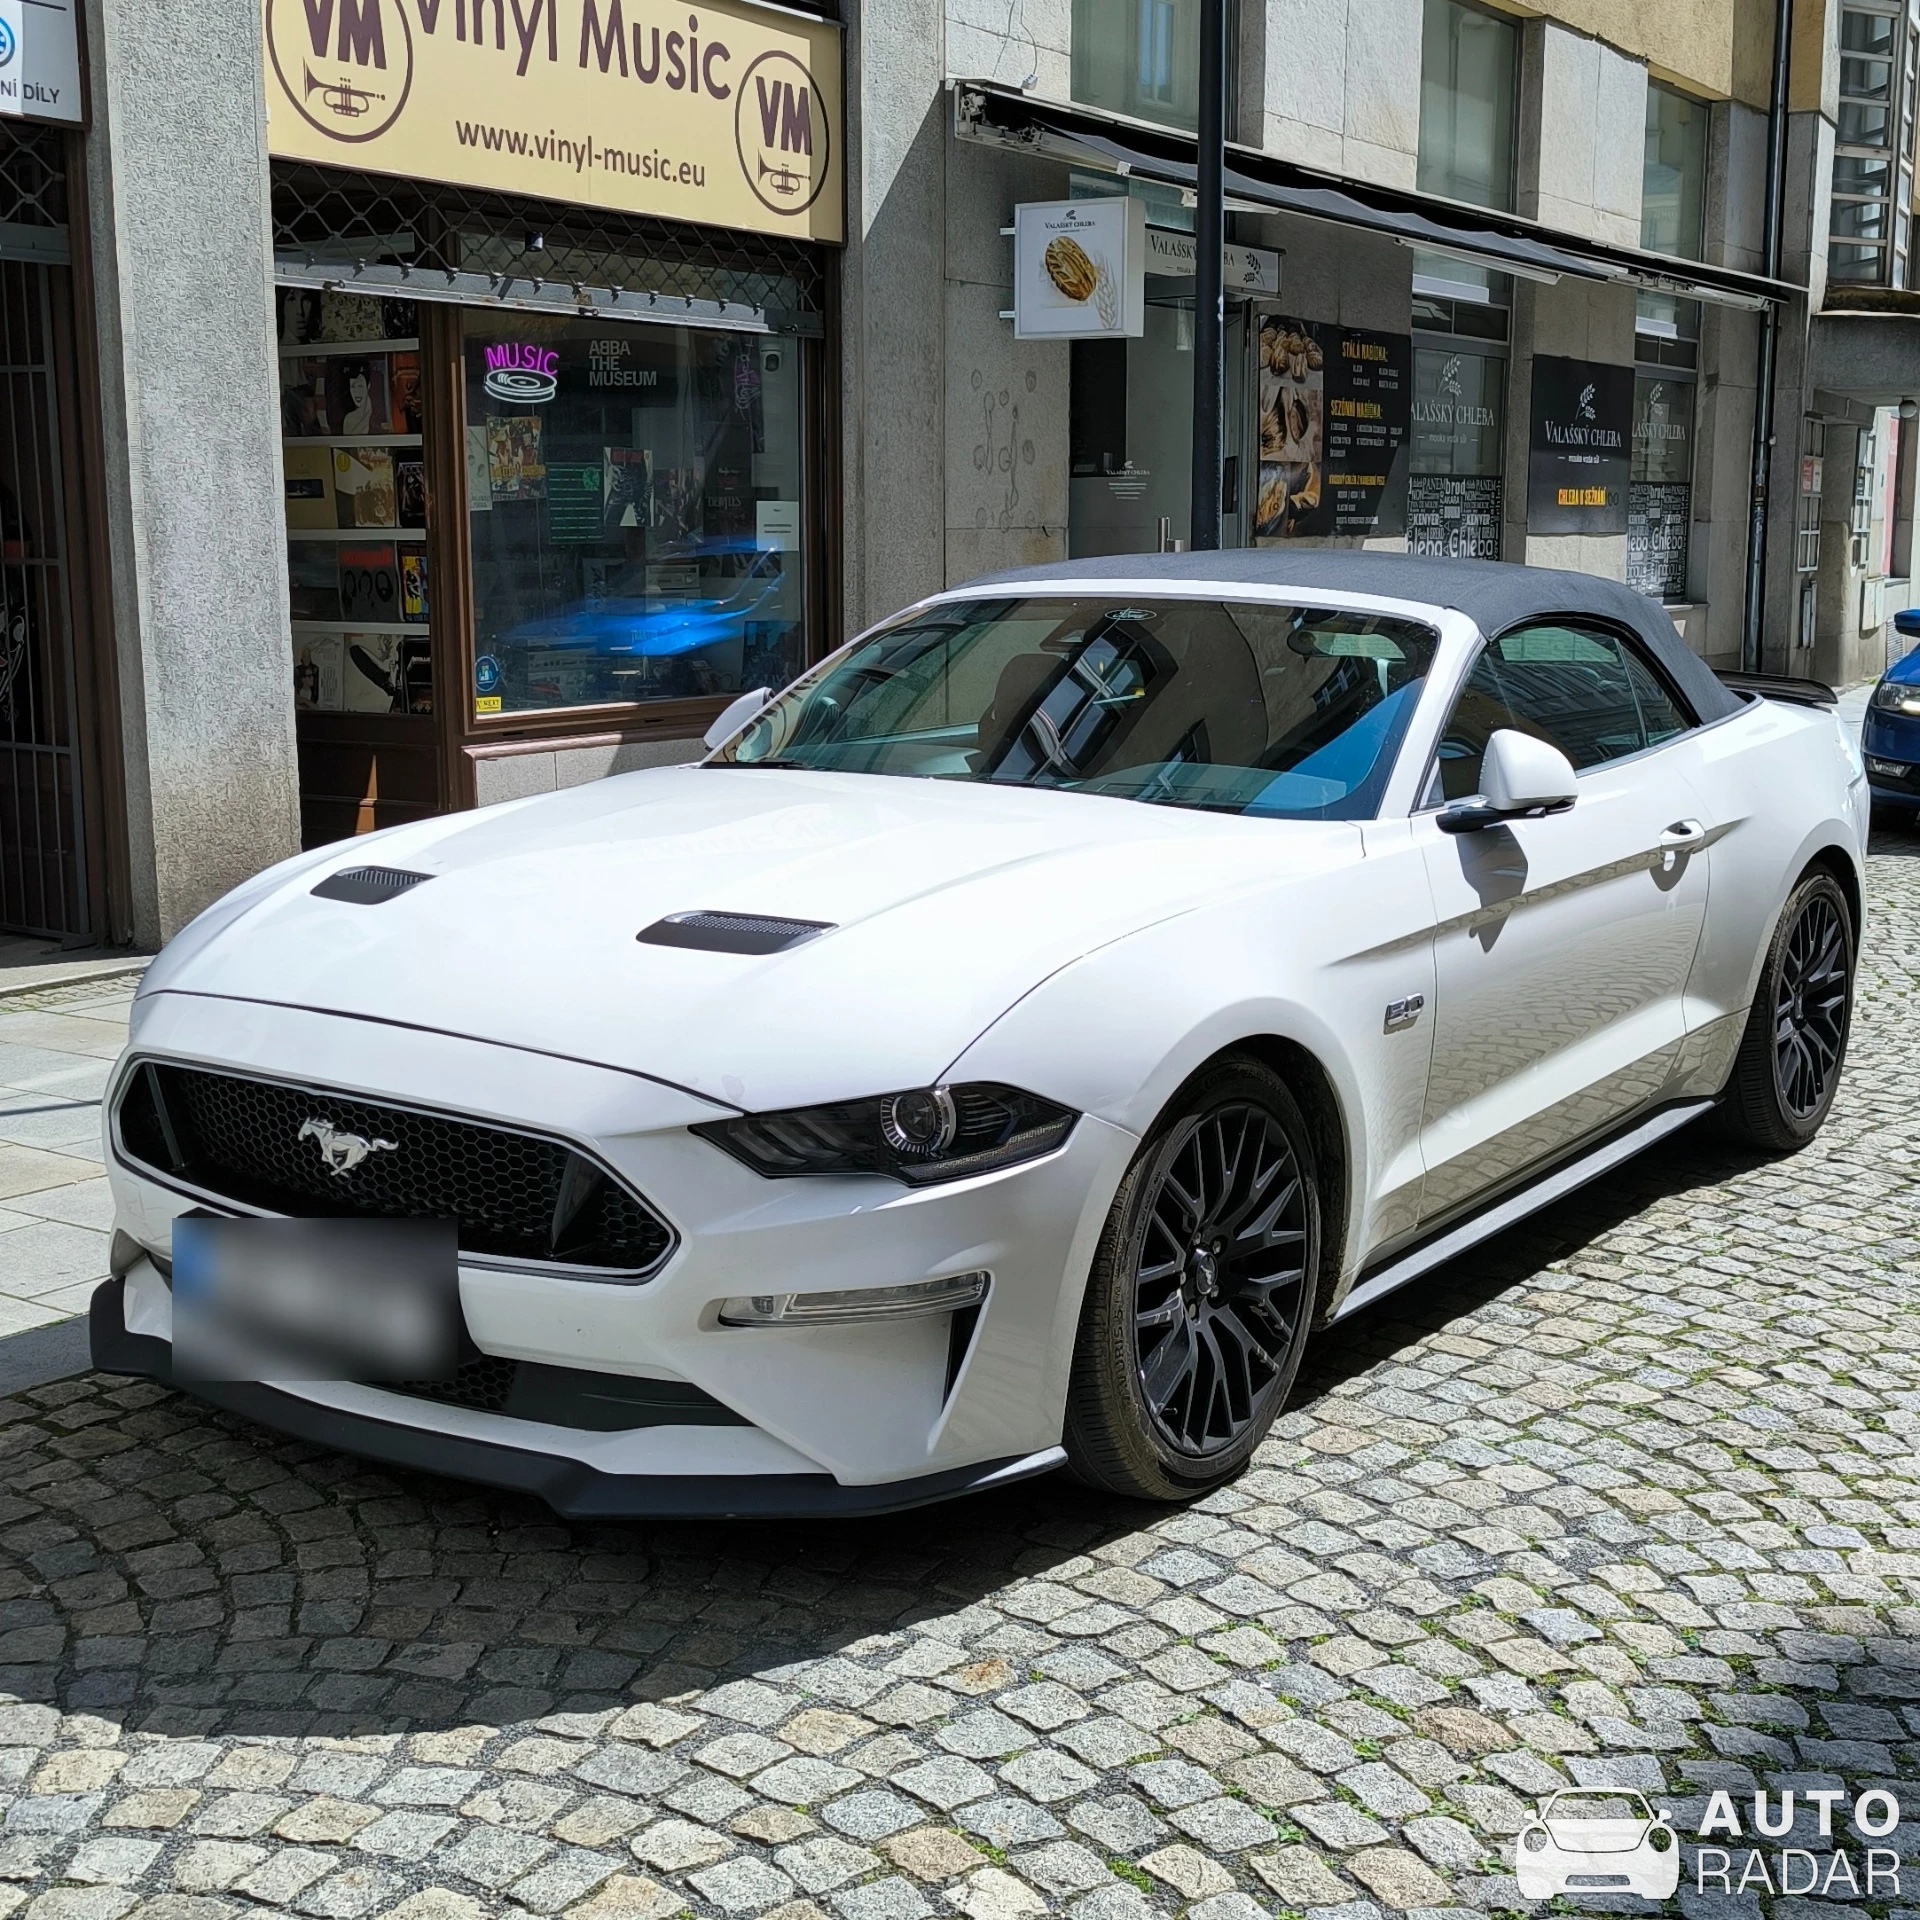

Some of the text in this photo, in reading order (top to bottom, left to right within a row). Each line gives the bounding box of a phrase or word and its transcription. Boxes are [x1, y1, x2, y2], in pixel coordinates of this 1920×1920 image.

[303, 0, 387, 70] VM
[579, 0, 731, 100] Music
[23, 82, 60, 104] DÍLY
[755, 75, 813, 156] VM
[455, 120, 706, 188] www.vinyl-music.eu
[484, 342, 559, 376] MUSIC
[588, 340, 631, 356] ABBA
[588, 355, 620, 371] THE
[588, 371, 657, 386] MUSEUM
[1410, 399, 1494, 427] ALAŠSKÝ CHLEBA
[1545, 420, 1622, 448] VALAŠSKÝ CHLEBA
[1658, 423, 1686, 440] CHLEBA
[1446, 478, 1466, 495] brod
[1449, 527, 1494, 559] Chleba
[1385, 993, 1424, 1025] 5.0
